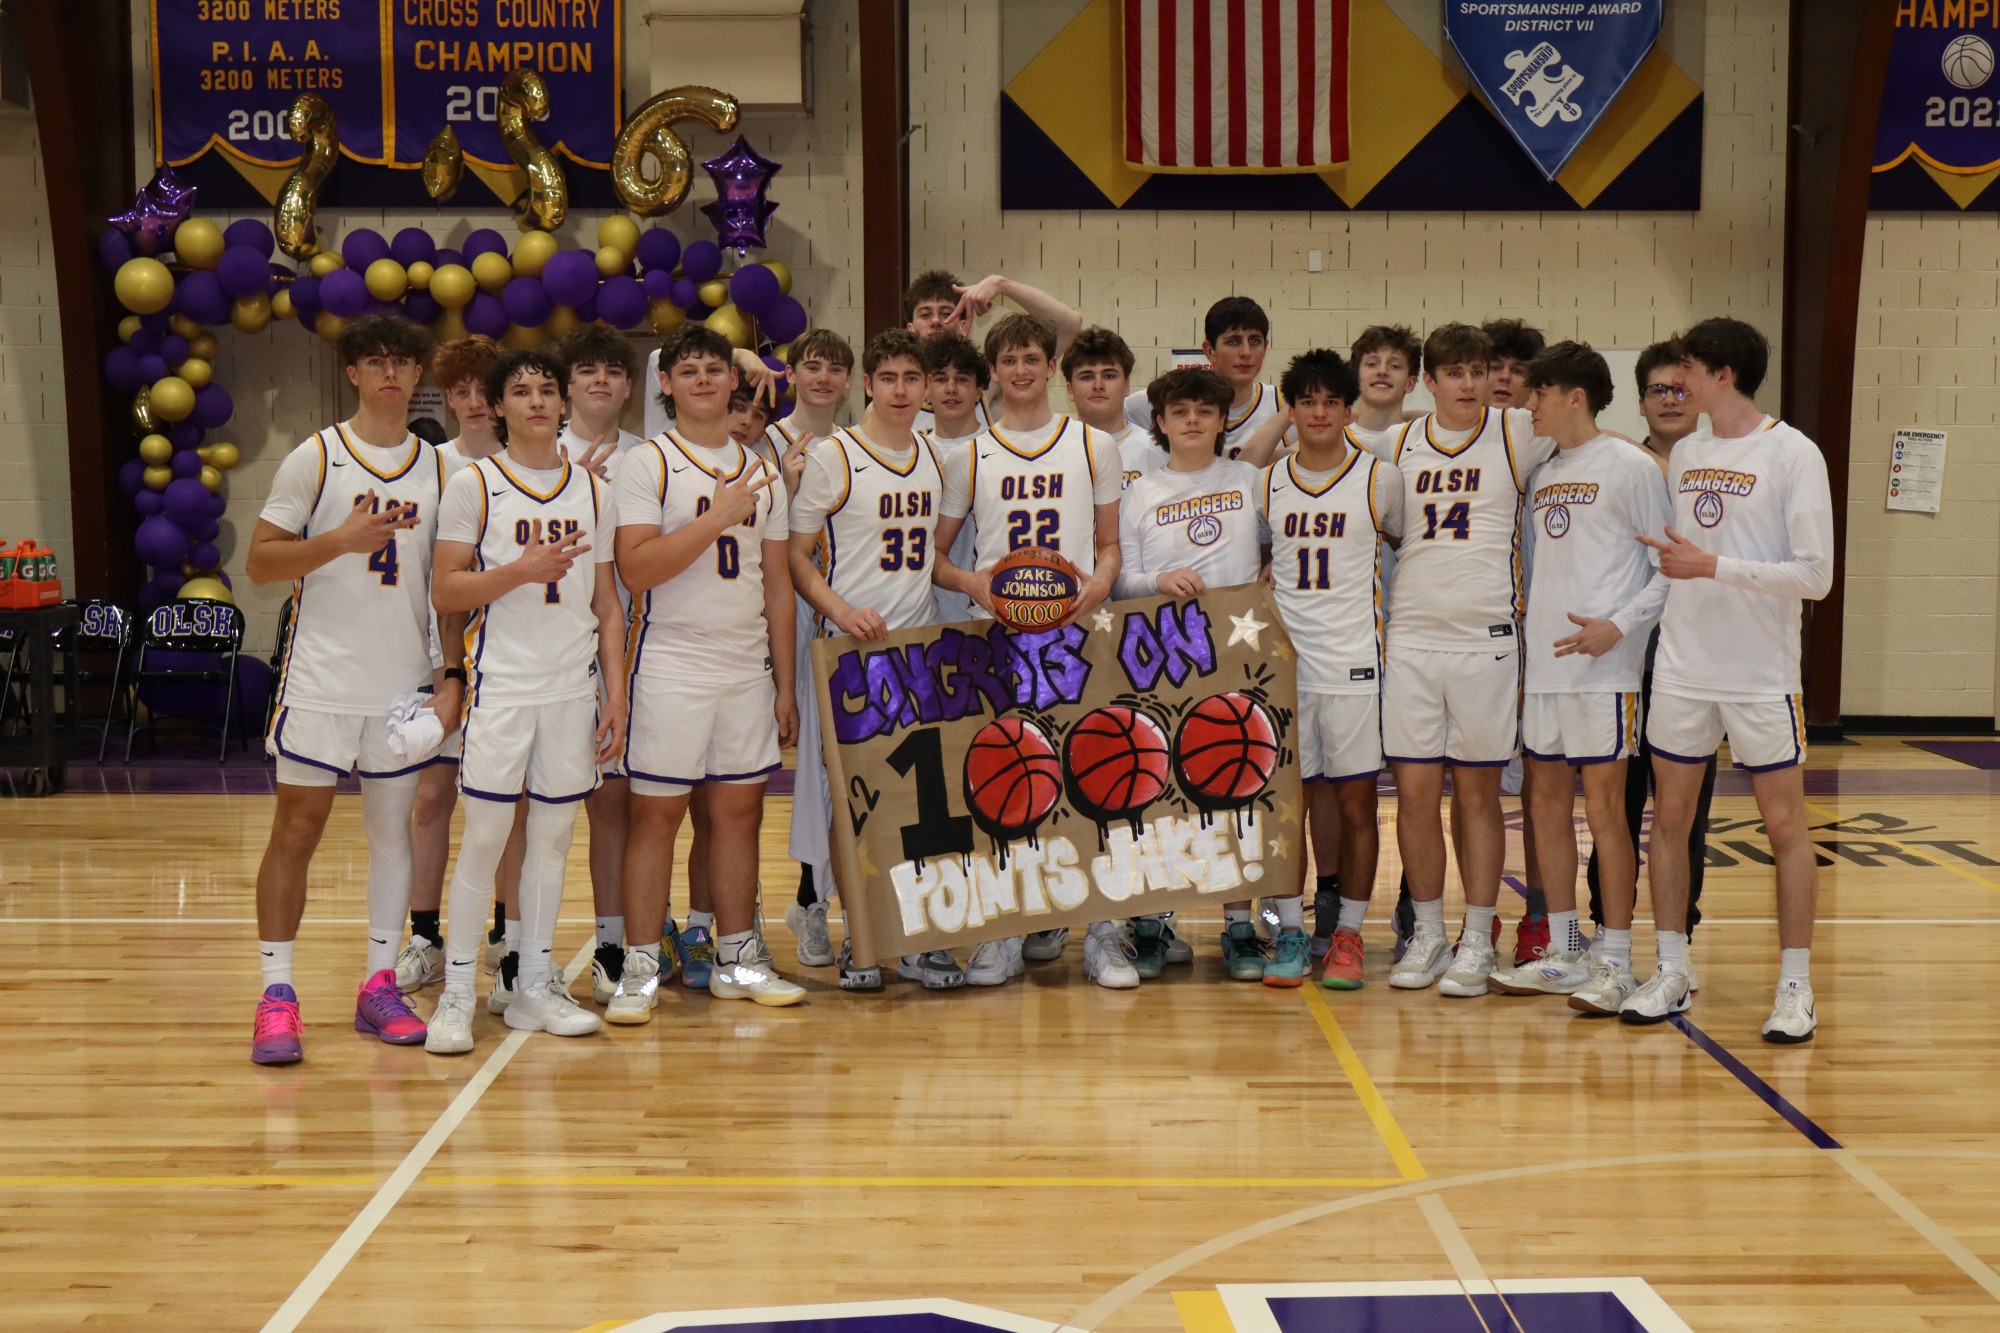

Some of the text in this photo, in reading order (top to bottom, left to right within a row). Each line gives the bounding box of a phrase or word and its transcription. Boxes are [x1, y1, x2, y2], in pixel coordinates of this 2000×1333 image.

[198, 0, 340, 20] 3200 METERS
[404, 0, 600, 28] CROSS COUNTRY
[1460, 2, 1642, 15] SPORTSMANSHIP AWARD
[1895, 0, 2000, 28] HAMPI
[1505, 20, 1594, 31] DISTRICT VII
[414, 40, 593, 73] CHAMPION
[200, 68, 343, 91] 3200 METERS
[1506, 45, 1554, 97] SPORTSMANSHIP
[1556, 96, 1578, 117] YOU
[1925, 96, 2000, 127] 202
[1911, 432, 1945, 440] EMERGENCY
[1001, 472, 1064, 501] OLSH
[1416, 467, 1481, 494] OLSH
[1679, 468, 1756, 497] CHARGERS
[878, 491, 931, 519] OLSH
[1157, 490, 1243, 526] CHARGERS
[1007, 508, 1061, 553] 22
[1197, 530, 1213, 539] OLSH
[1284, 511, 1347, 539] OLSH
[1422, 500, 1471, 541] 14
[367, 537, 400, 587] 4
[879, 525, 928, 572] 33
[1015, 568, 1054, 582] JAKE
[1296, 546, 1331, 591] 11
[1002, 581, 1066, 597] JOHNSON
[152, 604, 234, 638] OLSH
[1005, 600, 1062, 624] 1000
[828, 599, 1217, 744] CONGRATS ON
[889, 809, 1264, 936] POINTS JAKE!
